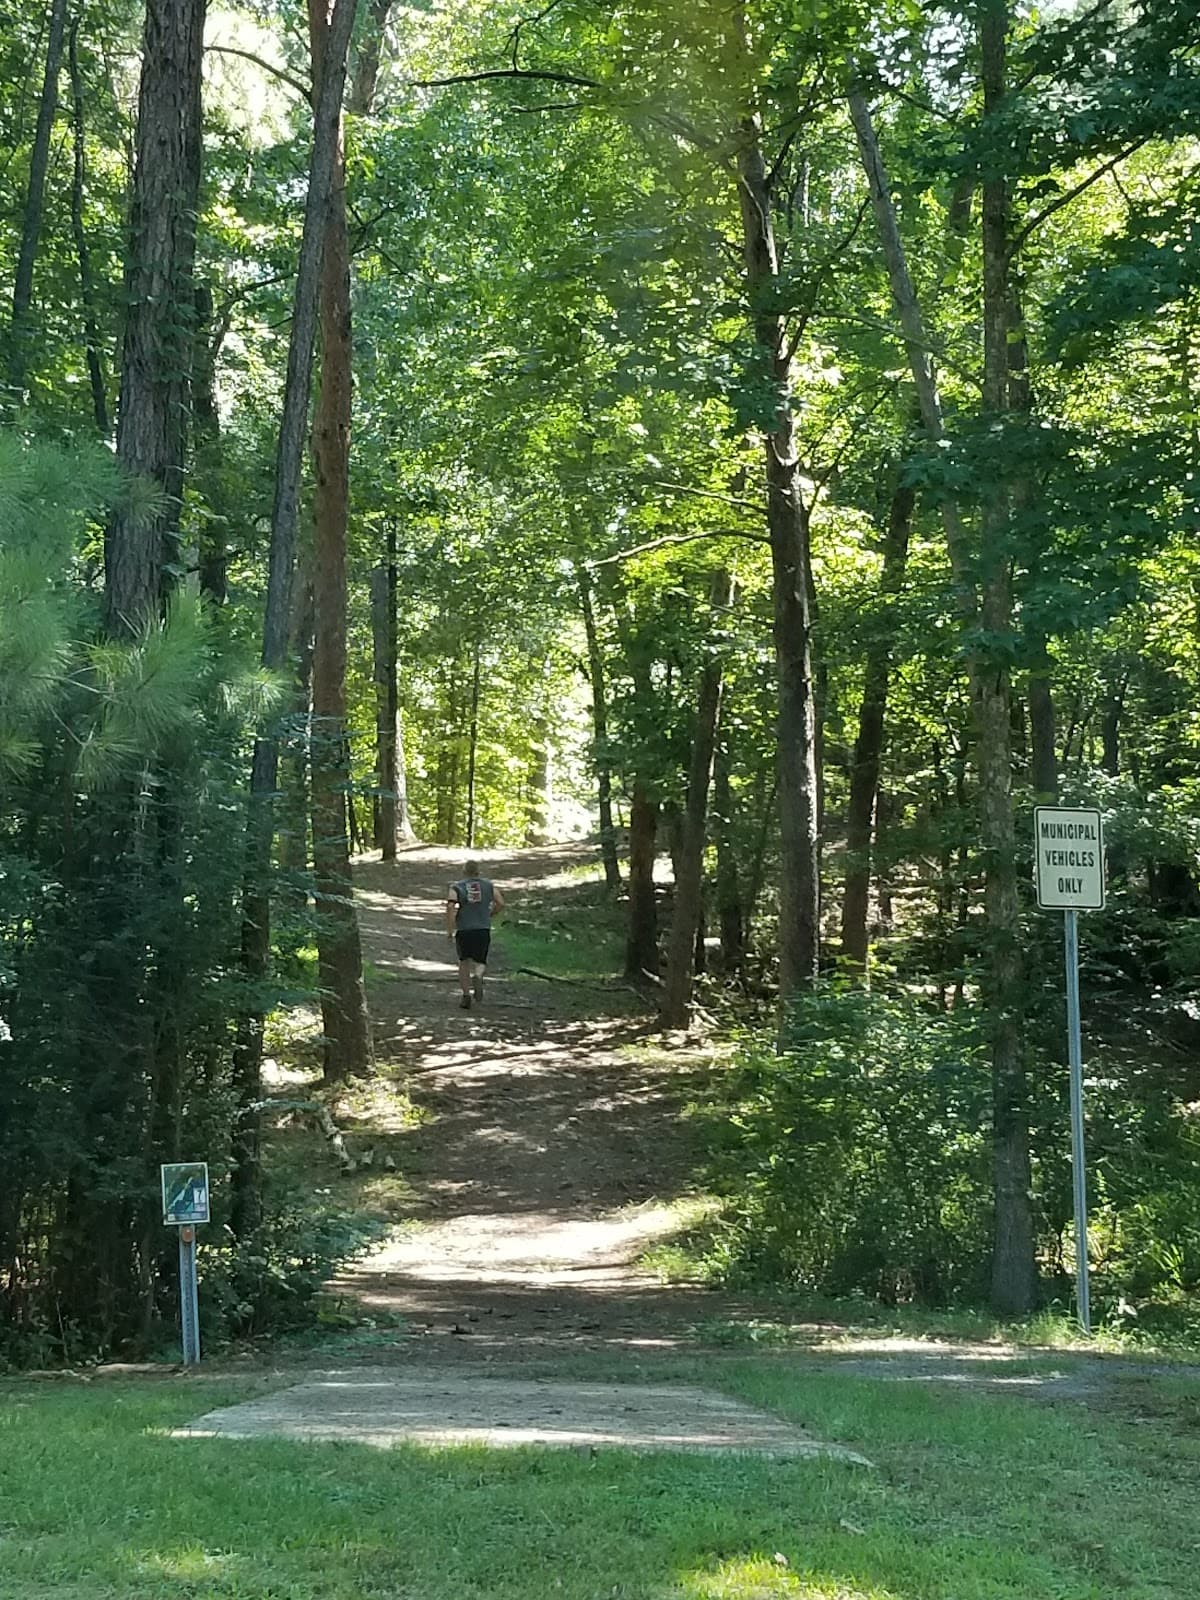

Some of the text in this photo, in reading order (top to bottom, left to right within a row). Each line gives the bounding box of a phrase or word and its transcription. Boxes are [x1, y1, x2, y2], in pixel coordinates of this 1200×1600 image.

[1041, 822, 1096, 840] MUNICIPAL
[1045, 850, 1095, 867] VEHICLES
[1058, 877, 1083, 893] ONLY
